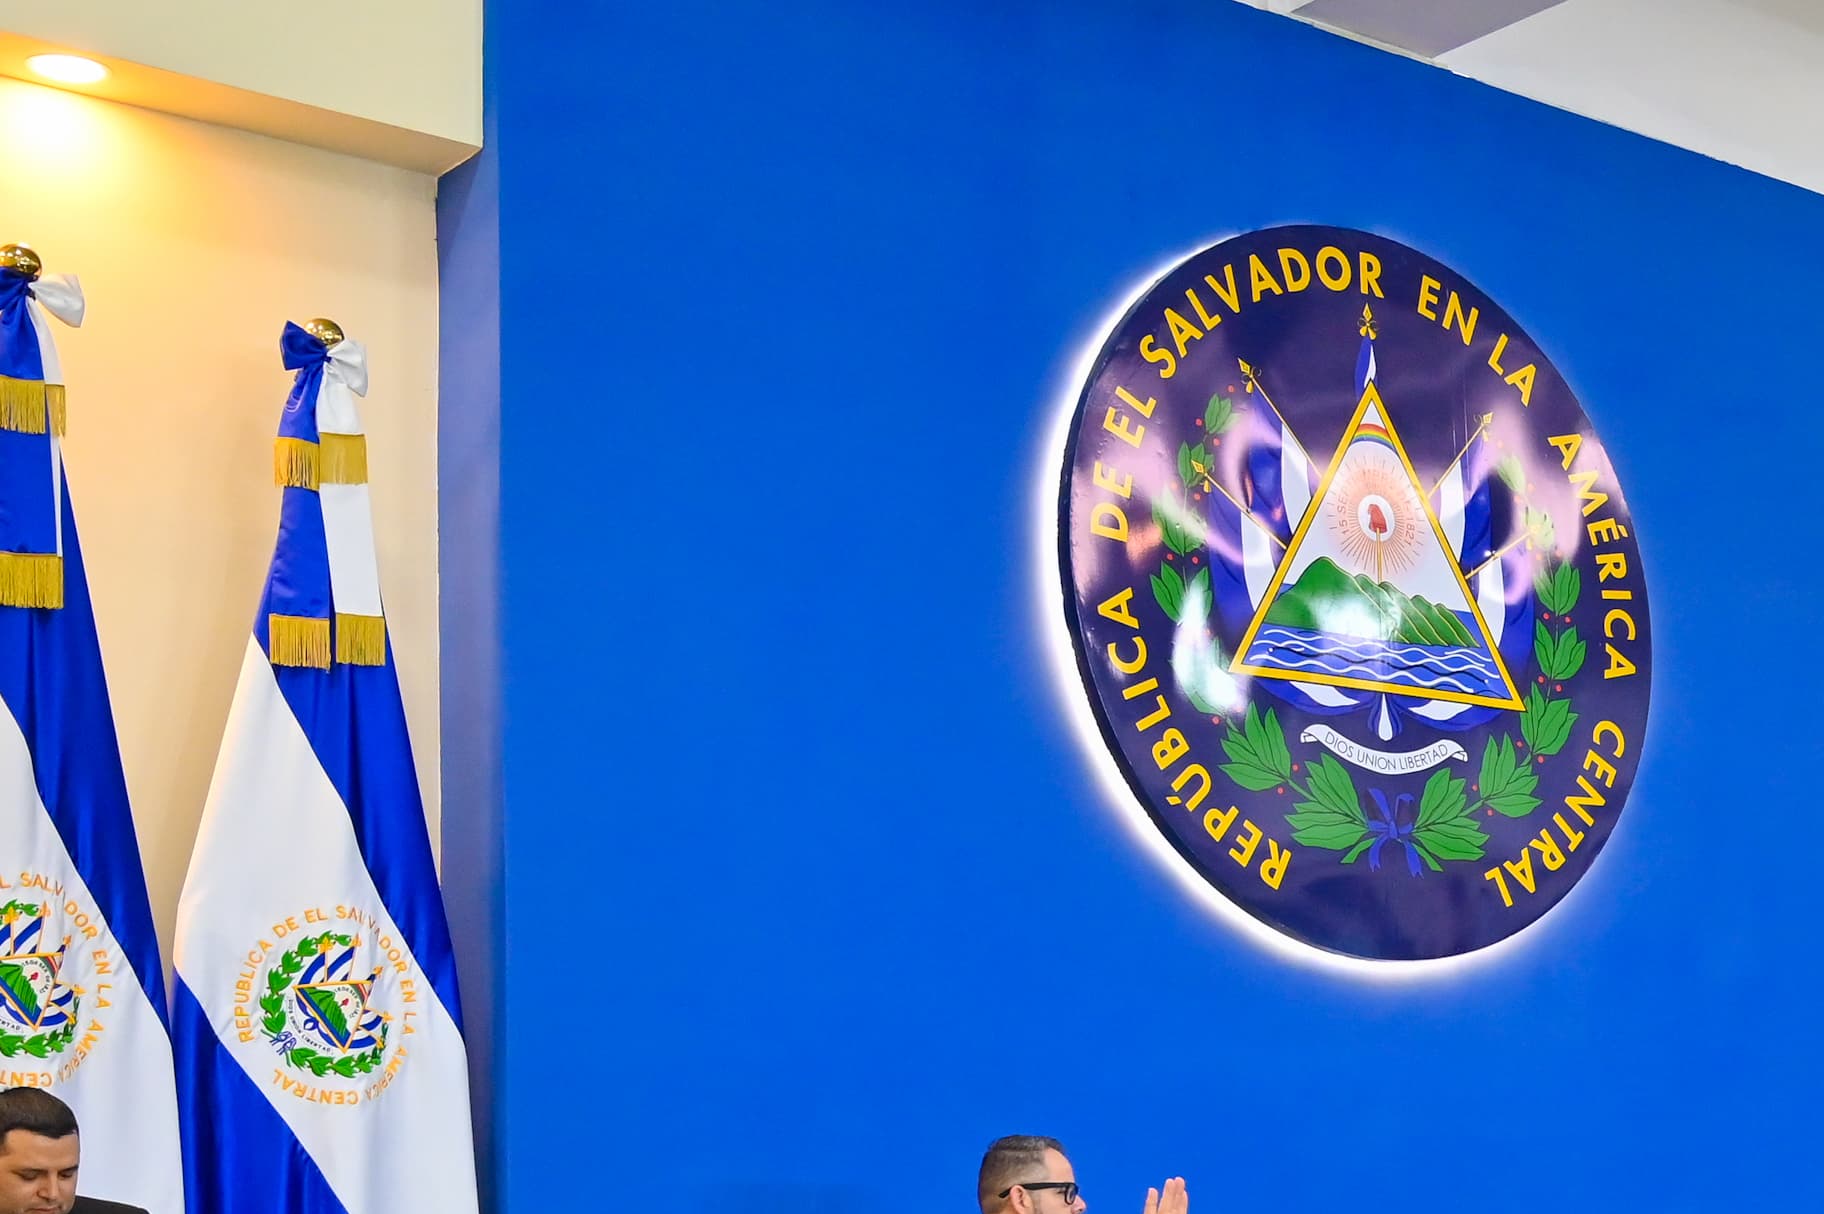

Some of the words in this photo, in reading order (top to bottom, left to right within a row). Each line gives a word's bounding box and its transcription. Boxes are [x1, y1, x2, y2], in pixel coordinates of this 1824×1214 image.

[1139, 246, 1384, 381] SALVADOR
[1417, 275, 1479, 348] EN
[1488, 332, 1537, 406] LA
[1103, 384, 1157, 448] EL
[1090, 460, 1135, 543] DE
[1548, 432, 1636, 680] AMÉRICA
[1097, 586, 1292, 890] REPÚBLICA
[1324, 731, 1354, 758] DIOS
[1357, 749, 1397, 770] UNION
[1399, 744, 1448, 769] LIBERTAD
[1485, 719, 1625, 908] CENTRAL
[20, 871, 98, 940] SALVDOR
[272, 917, 299, 938] DE
[304, 908, 328, 923] EL
[92, 949, 112, 975] EN
[234, 939, 273, 1043] REPUBLICA
[400, 979, 416, 1003] EN
[96, 983, 112, 1009] LA
[403, 1012, 416, 1035] LA
[0, 1070, 53, 1088] CENT
[273, 1069, 360, 1105] CENTRAL
